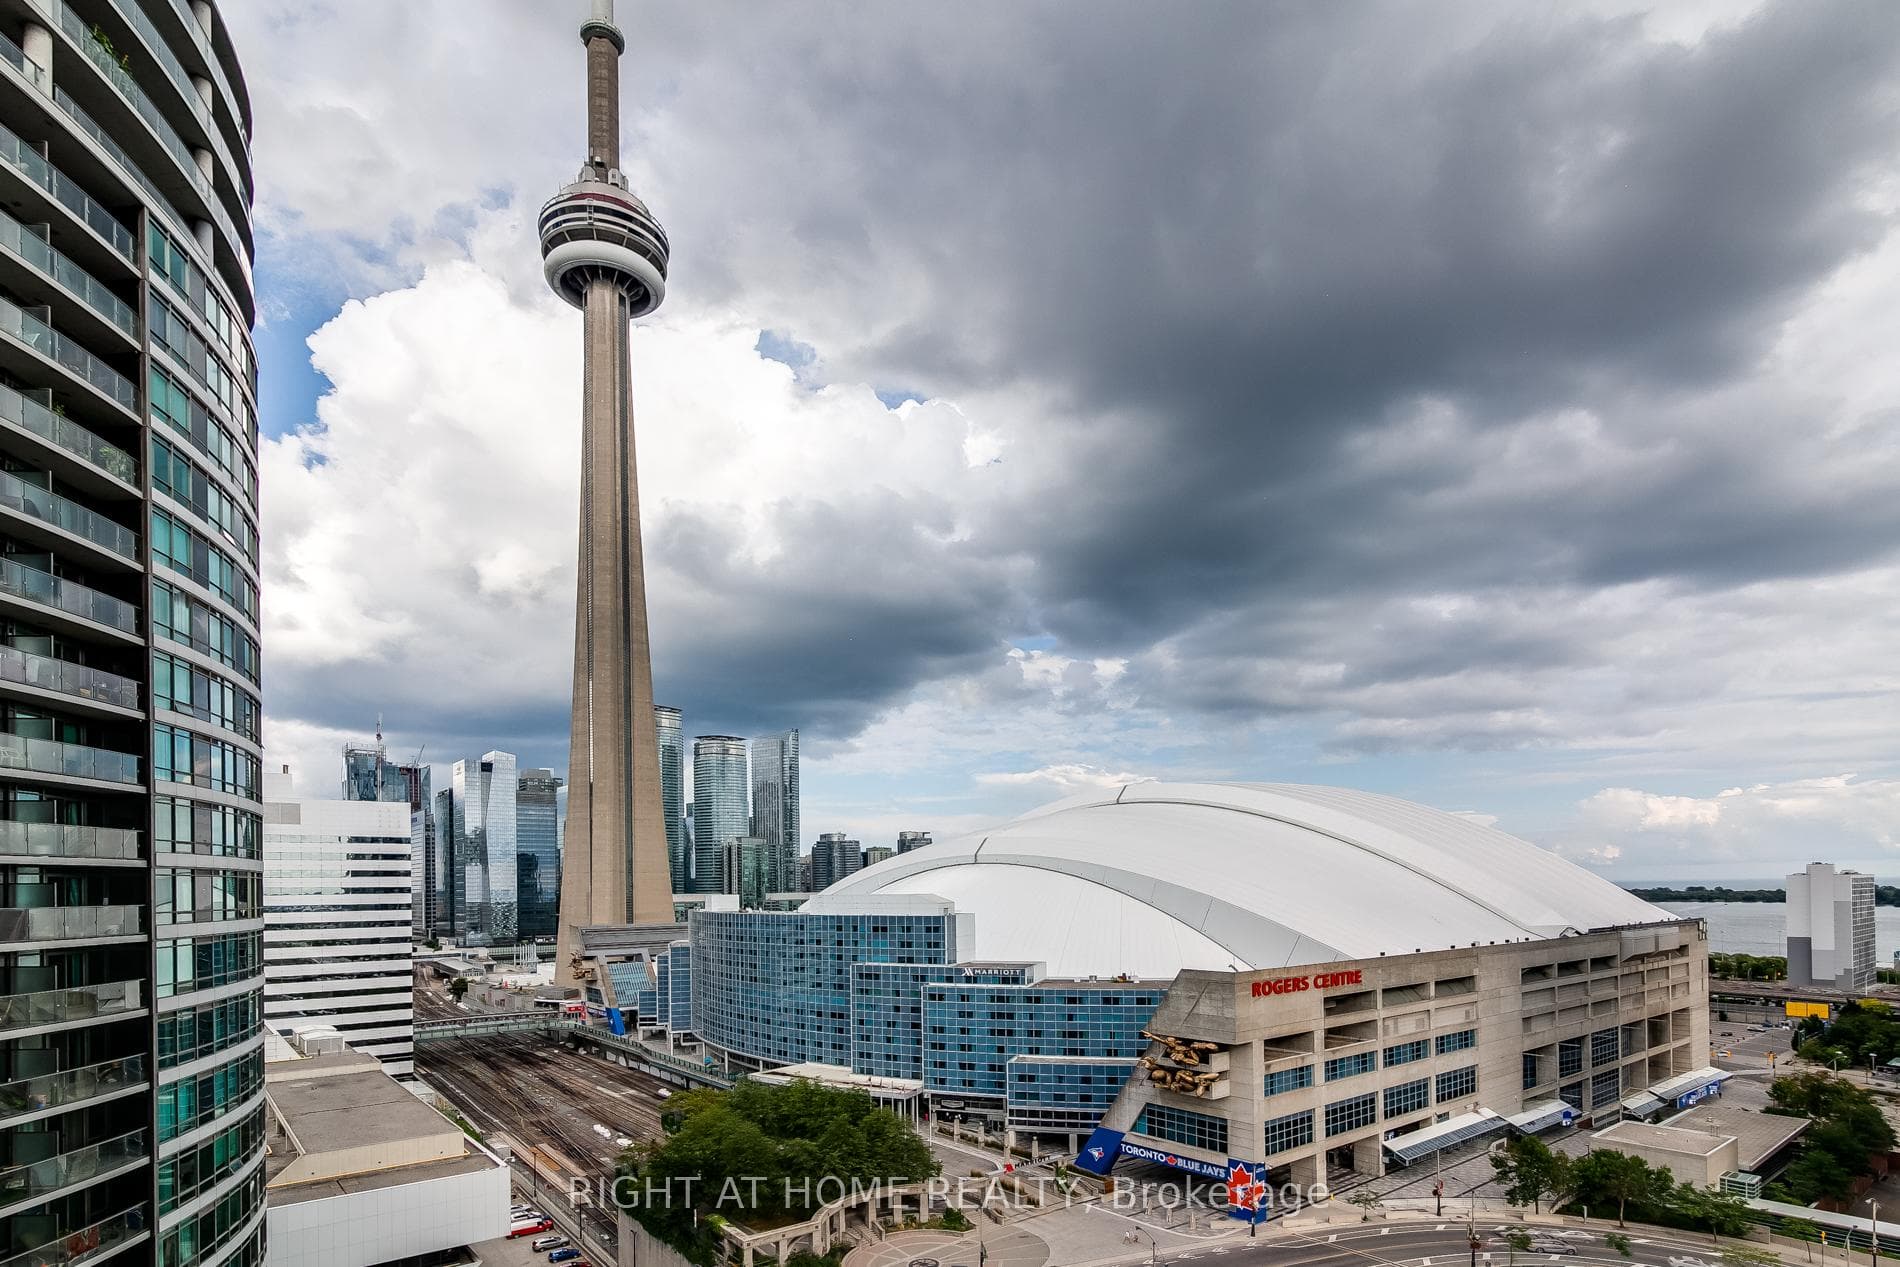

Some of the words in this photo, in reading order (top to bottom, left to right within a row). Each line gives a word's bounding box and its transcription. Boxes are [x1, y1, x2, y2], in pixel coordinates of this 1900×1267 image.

[1251, 976, 1309, 998] ROGERS
[1313, 969, 1362, 989] CENTRE
[1120, 1143, 1167, 1162] TORONTO
[1177, 1157, 1200, 1172] BLUE
[1201, 1164, 1226, 1179] JAYS
